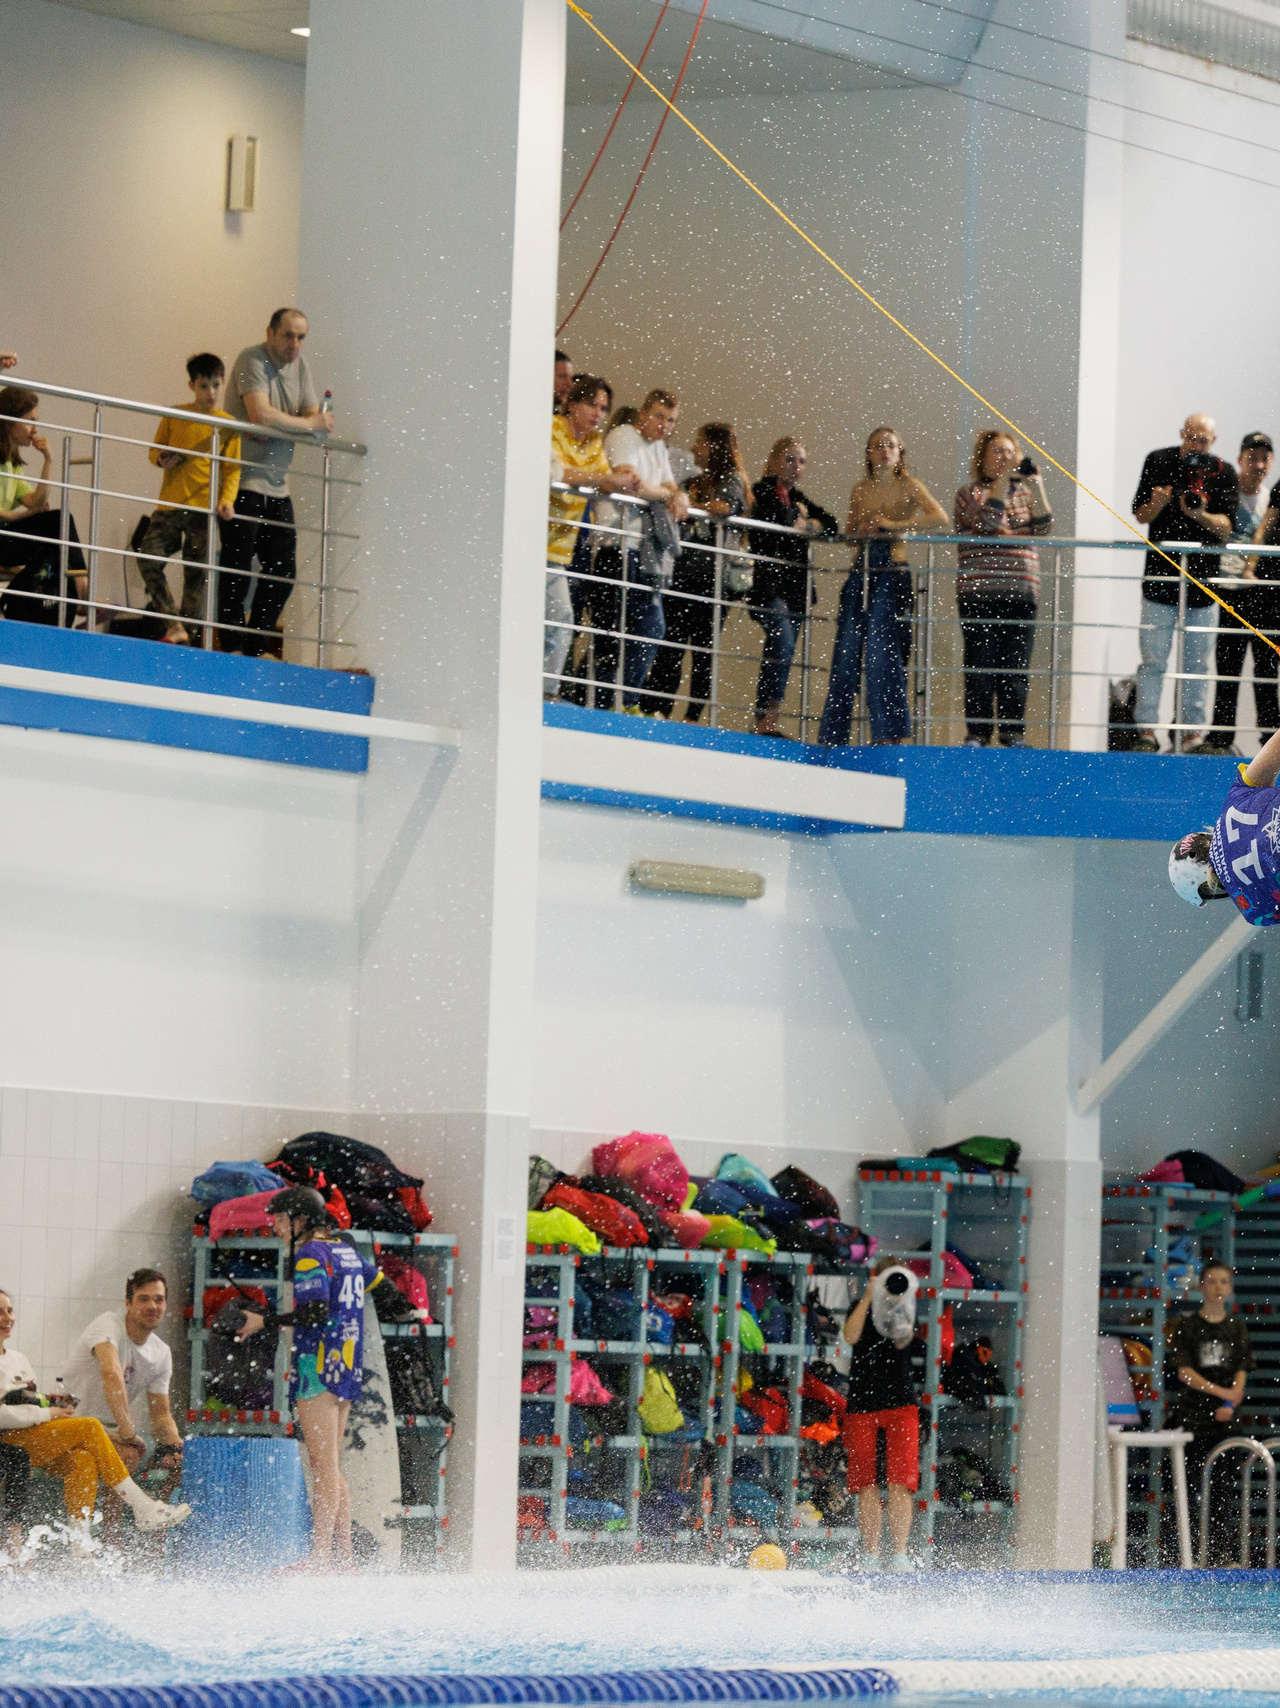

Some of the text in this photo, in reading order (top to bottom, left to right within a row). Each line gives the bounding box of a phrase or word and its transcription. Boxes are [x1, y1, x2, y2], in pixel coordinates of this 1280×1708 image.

[1216, 817, 1231, 883] CHALLENGE
[1225, 805, 1265, 886] 17
[338, 1274, 365, 1309] 49
